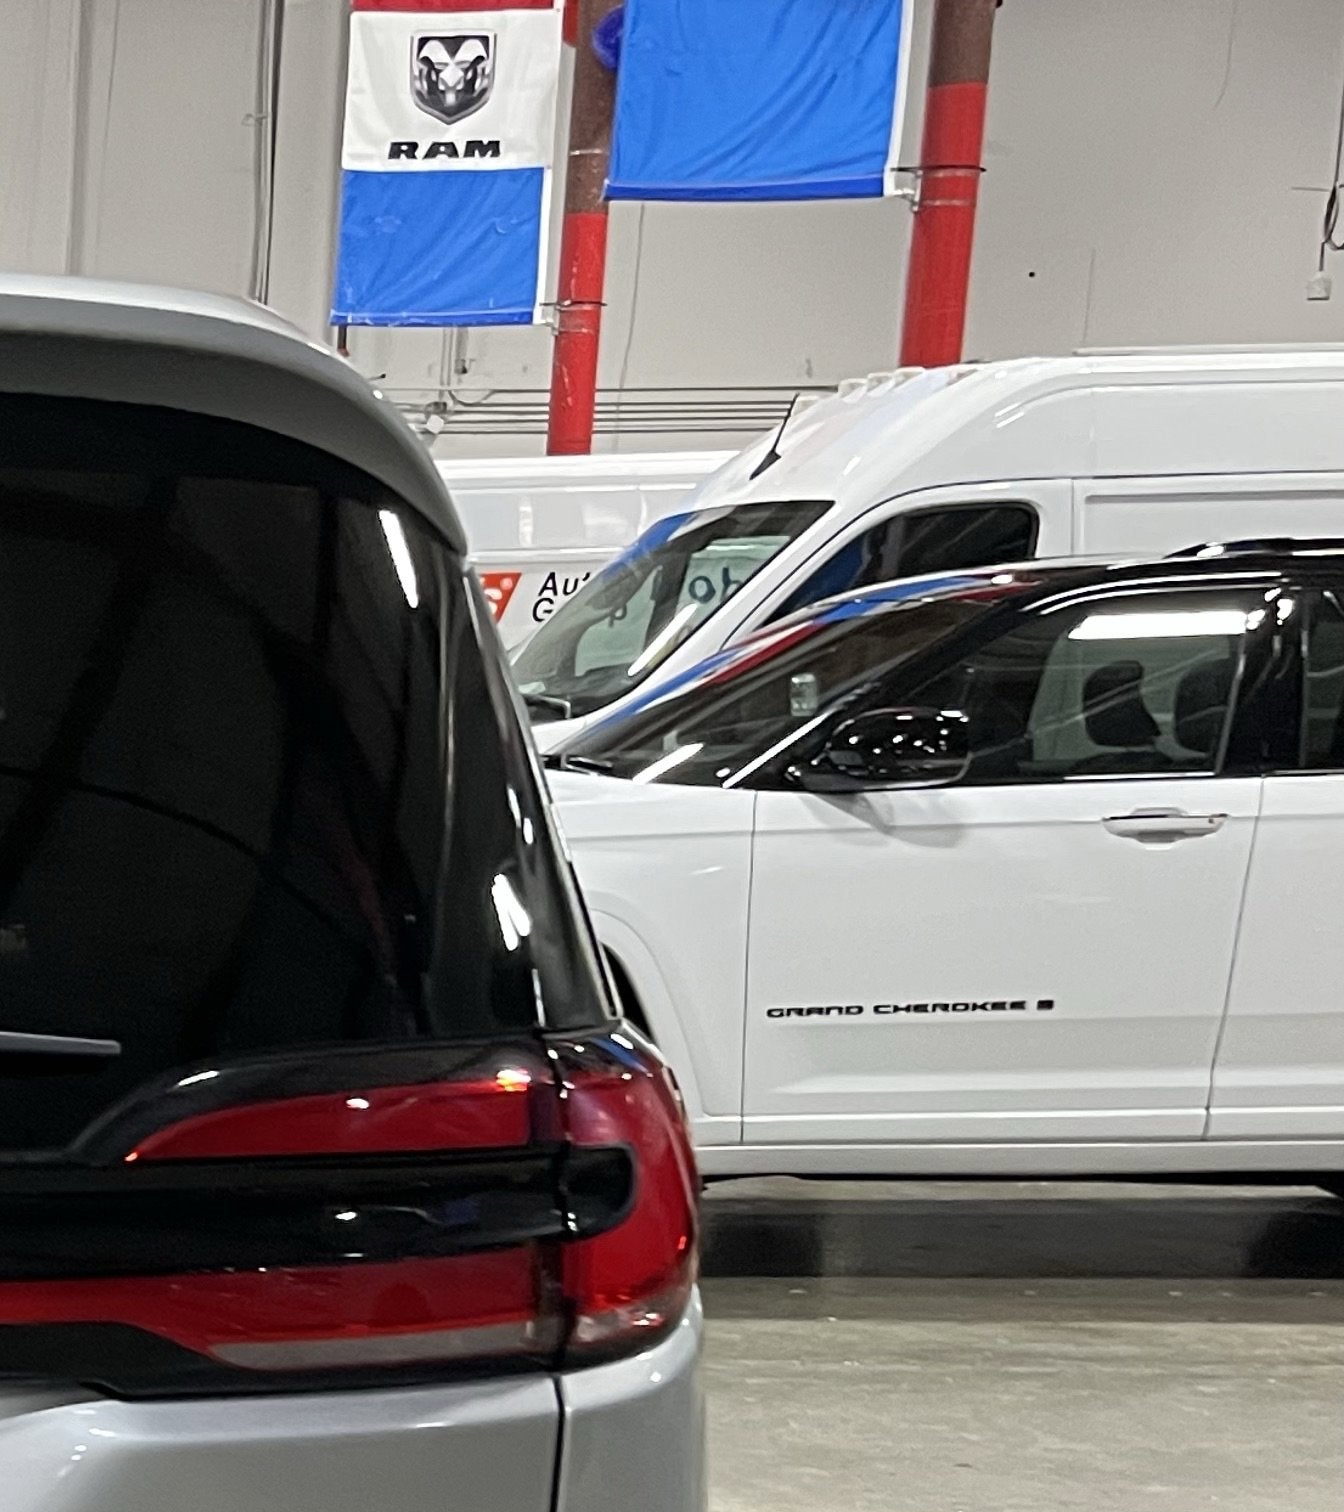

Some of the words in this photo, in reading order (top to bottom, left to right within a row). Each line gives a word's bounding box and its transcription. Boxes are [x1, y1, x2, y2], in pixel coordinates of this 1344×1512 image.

[387, 139, 502, 160] RAM
[766, 1004, 864, 1018] GRAND
[873, 1000, 1026, 1014] CHEROKEE
